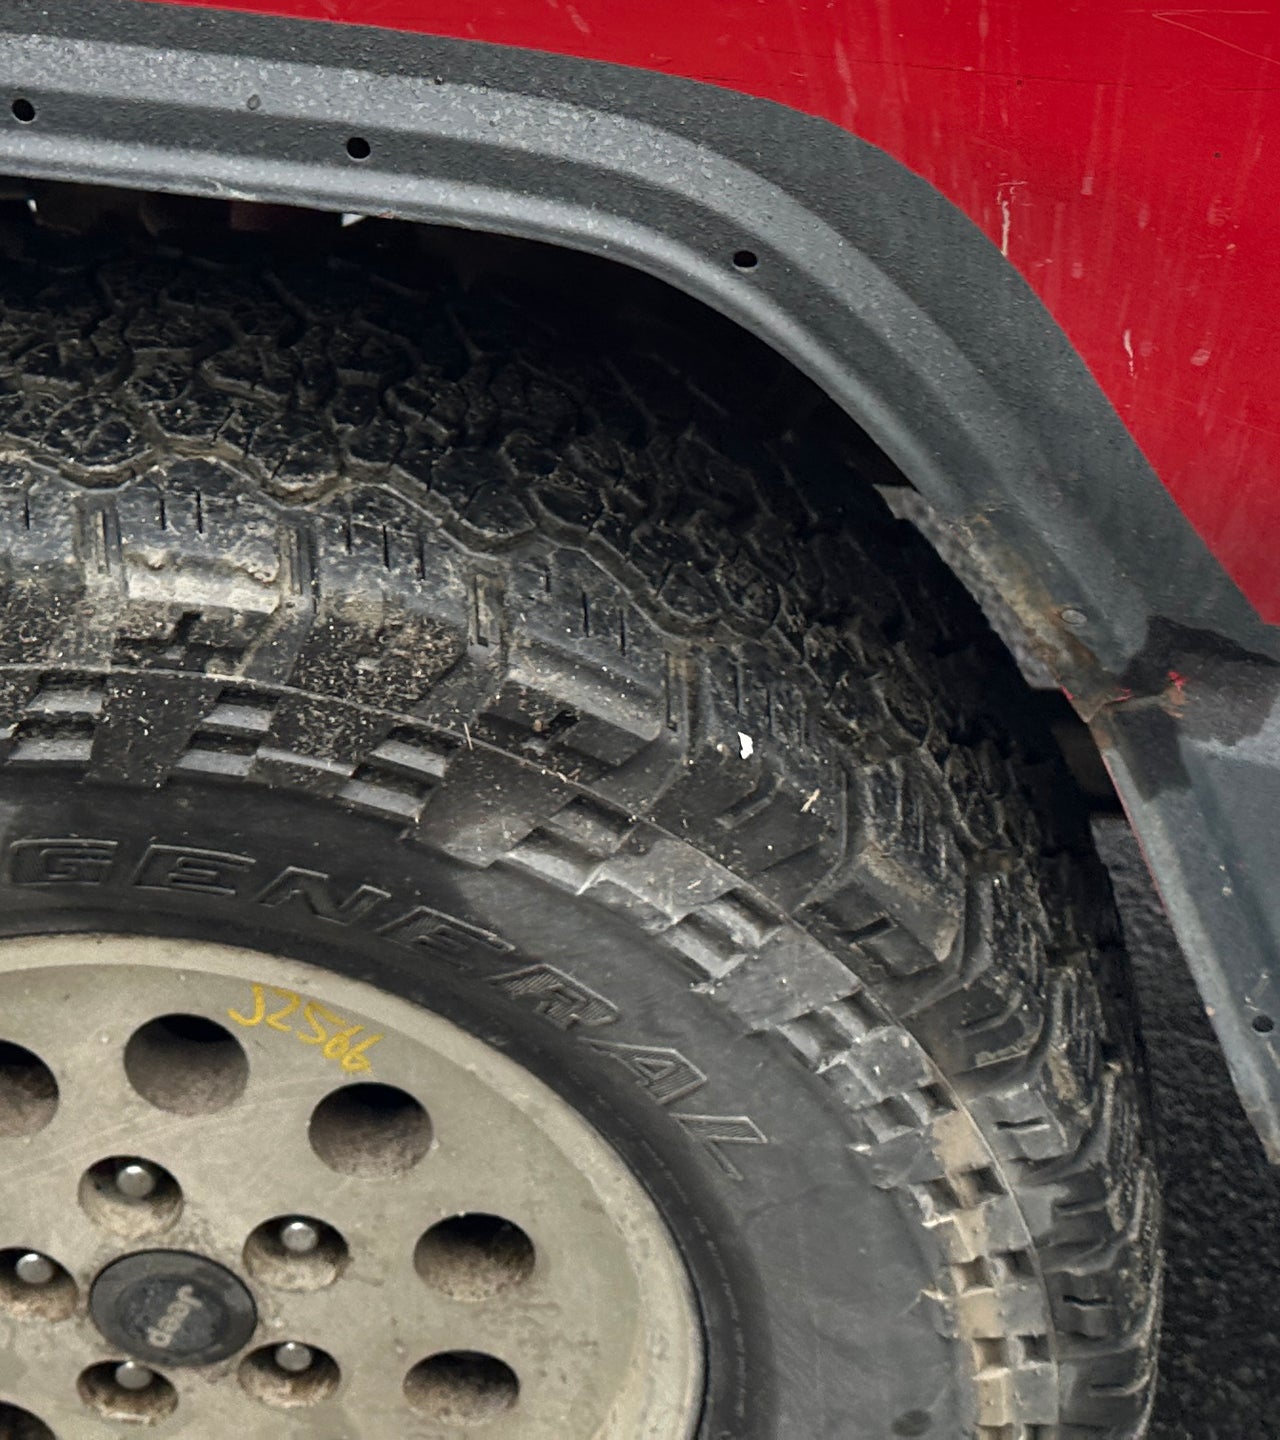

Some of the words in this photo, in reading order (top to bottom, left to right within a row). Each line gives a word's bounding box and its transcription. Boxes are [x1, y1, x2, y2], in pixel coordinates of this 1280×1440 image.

[4, 836, 767, 1181] GENERAL
[227, 982, 384, 1074] J2566
[146, 1283, 203, 1348] Jeep
